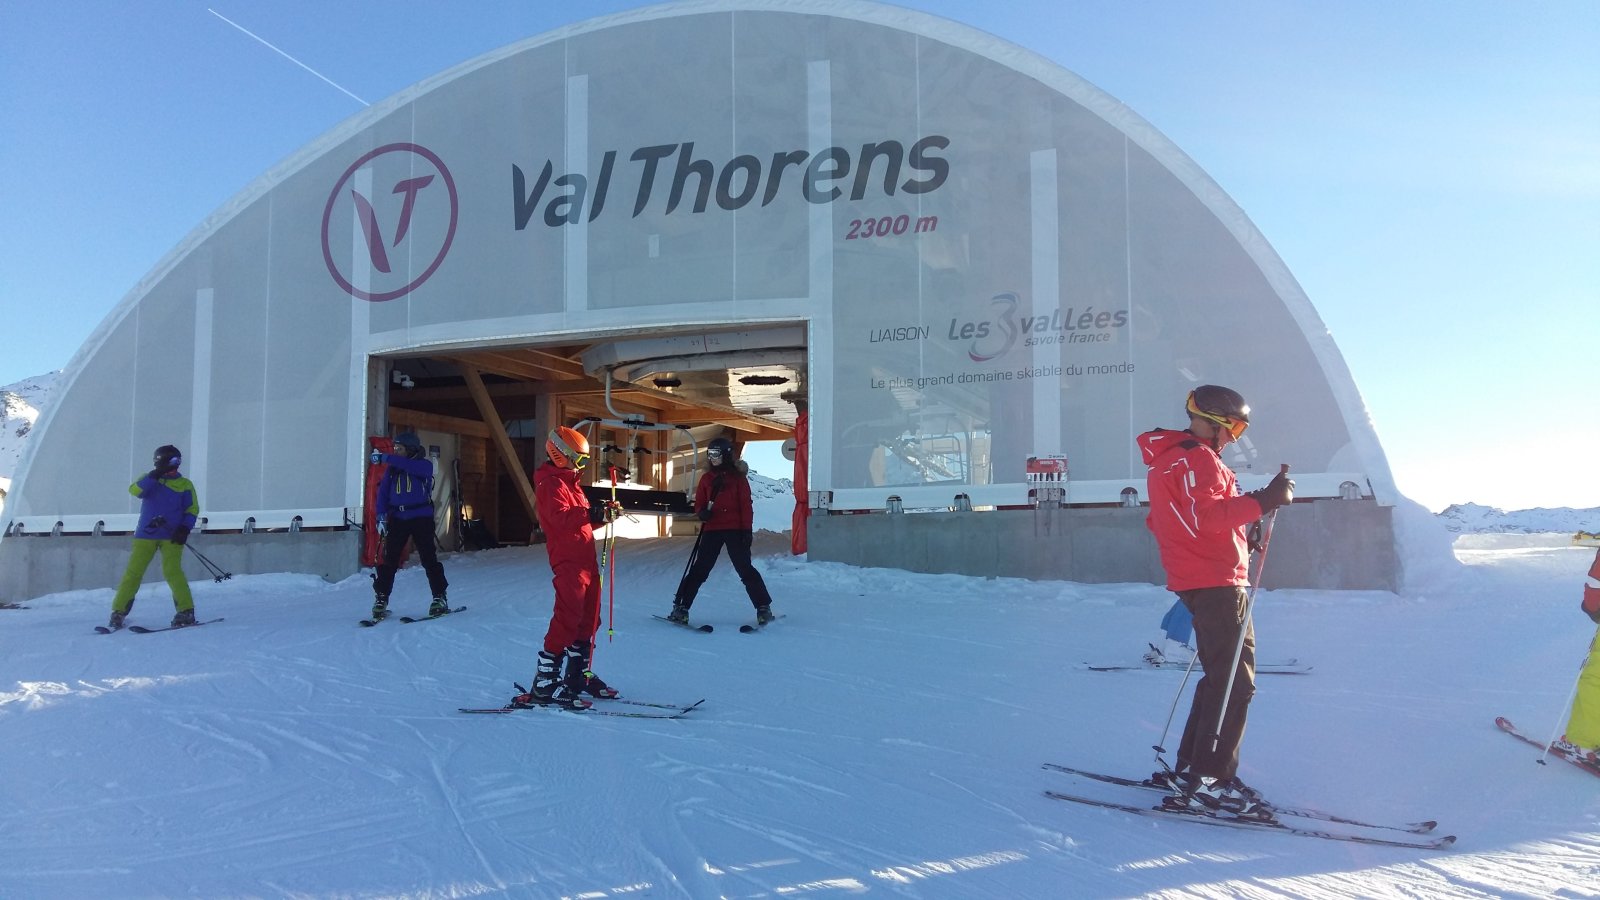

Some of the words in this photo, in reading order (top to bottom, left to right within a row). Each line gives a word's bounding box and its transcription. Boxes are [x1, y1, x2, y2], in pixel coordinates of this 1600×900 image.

[511, 150, 617, 231] Val
[629, 134, 951, 219] Thorens
[845, 214, 910, 240] 2300
[914, 216, 938, 233] m
[869, 326, 930, 343] LIAISON
[948, 318, 991, 341] Les
[1024, 333, 1065, 347] savoie
[1068, 332, 1111, 344] france
[871, 378, 885, 389] Le
[889, 376, 914, 390] plus
[917, 373, 954, 389] grand
[957, 369, 1013, 384] domaine
[1017, 364, 1062, 380] skiable
[1066, 364, 1083, 376] du
[1087, 361, 1135, 375] monde
